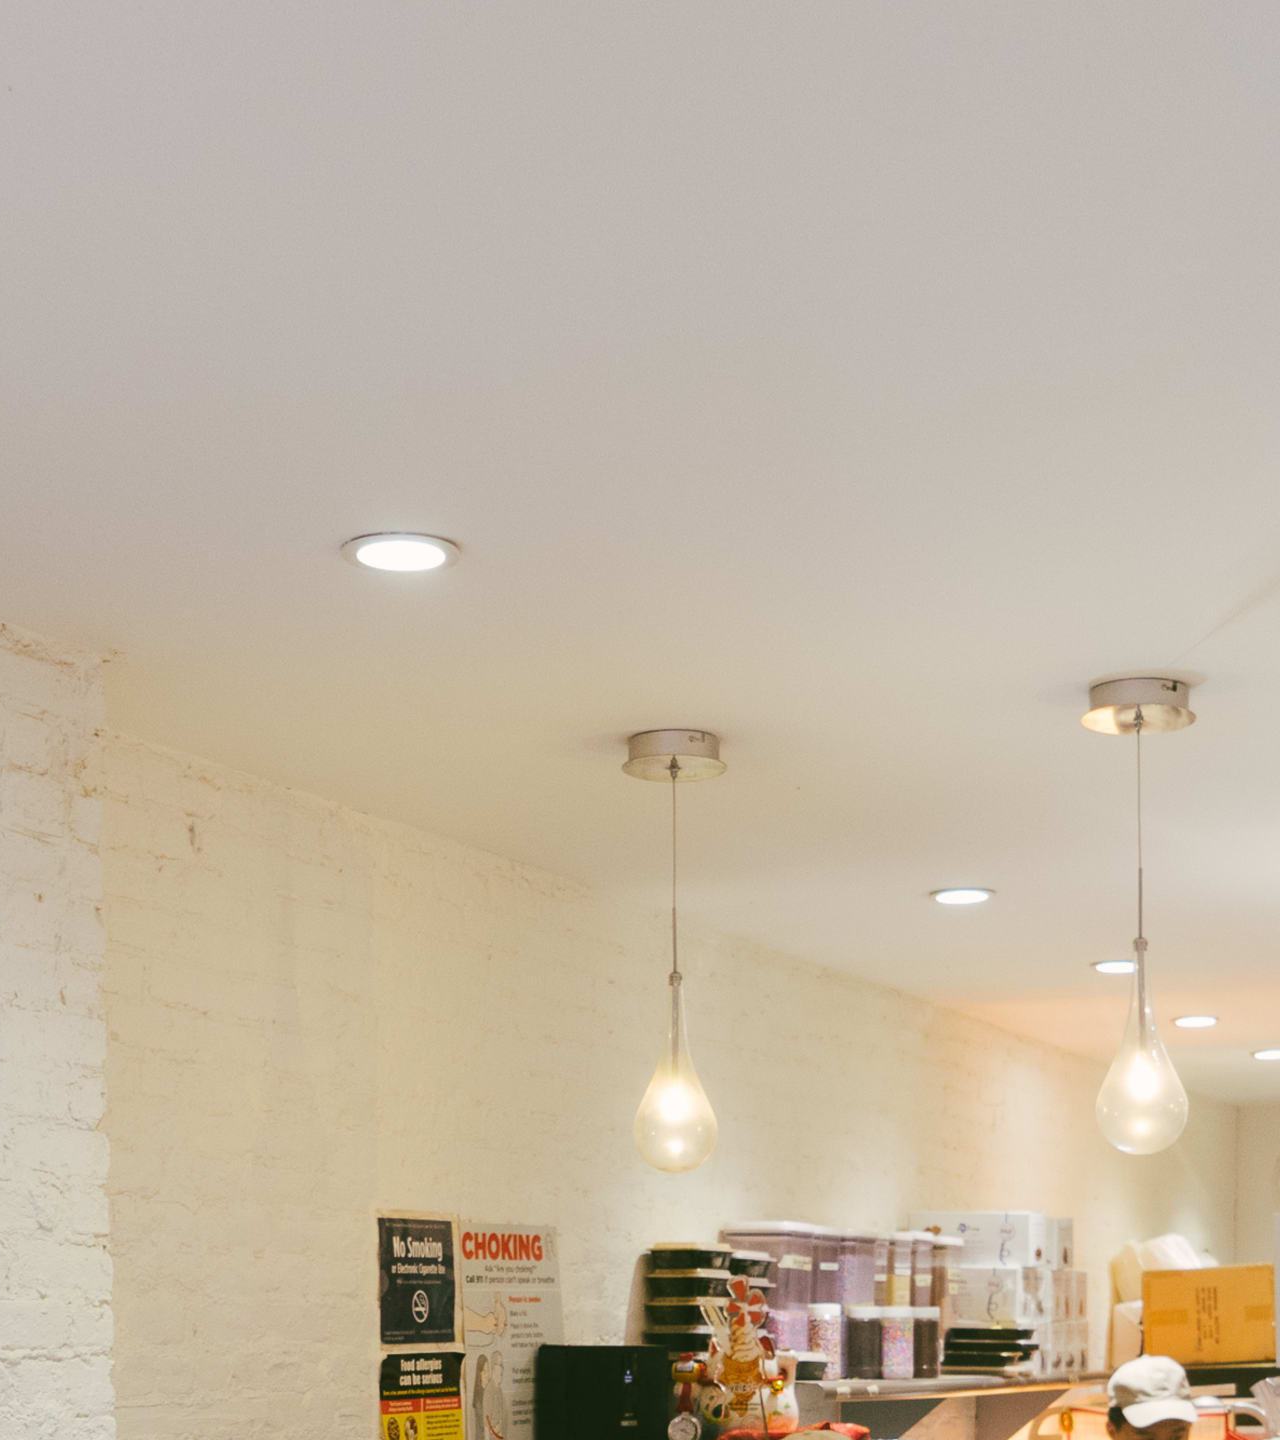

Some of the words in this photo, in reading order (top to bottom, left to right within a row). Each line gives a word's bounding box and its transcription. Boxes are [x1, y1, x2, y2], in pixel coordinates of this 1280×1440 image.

[392, 1235, 406, 1258] No
[406, 1236, 443, 1262] Smoking
[462, 1231, 543, 1262] CHOKING
